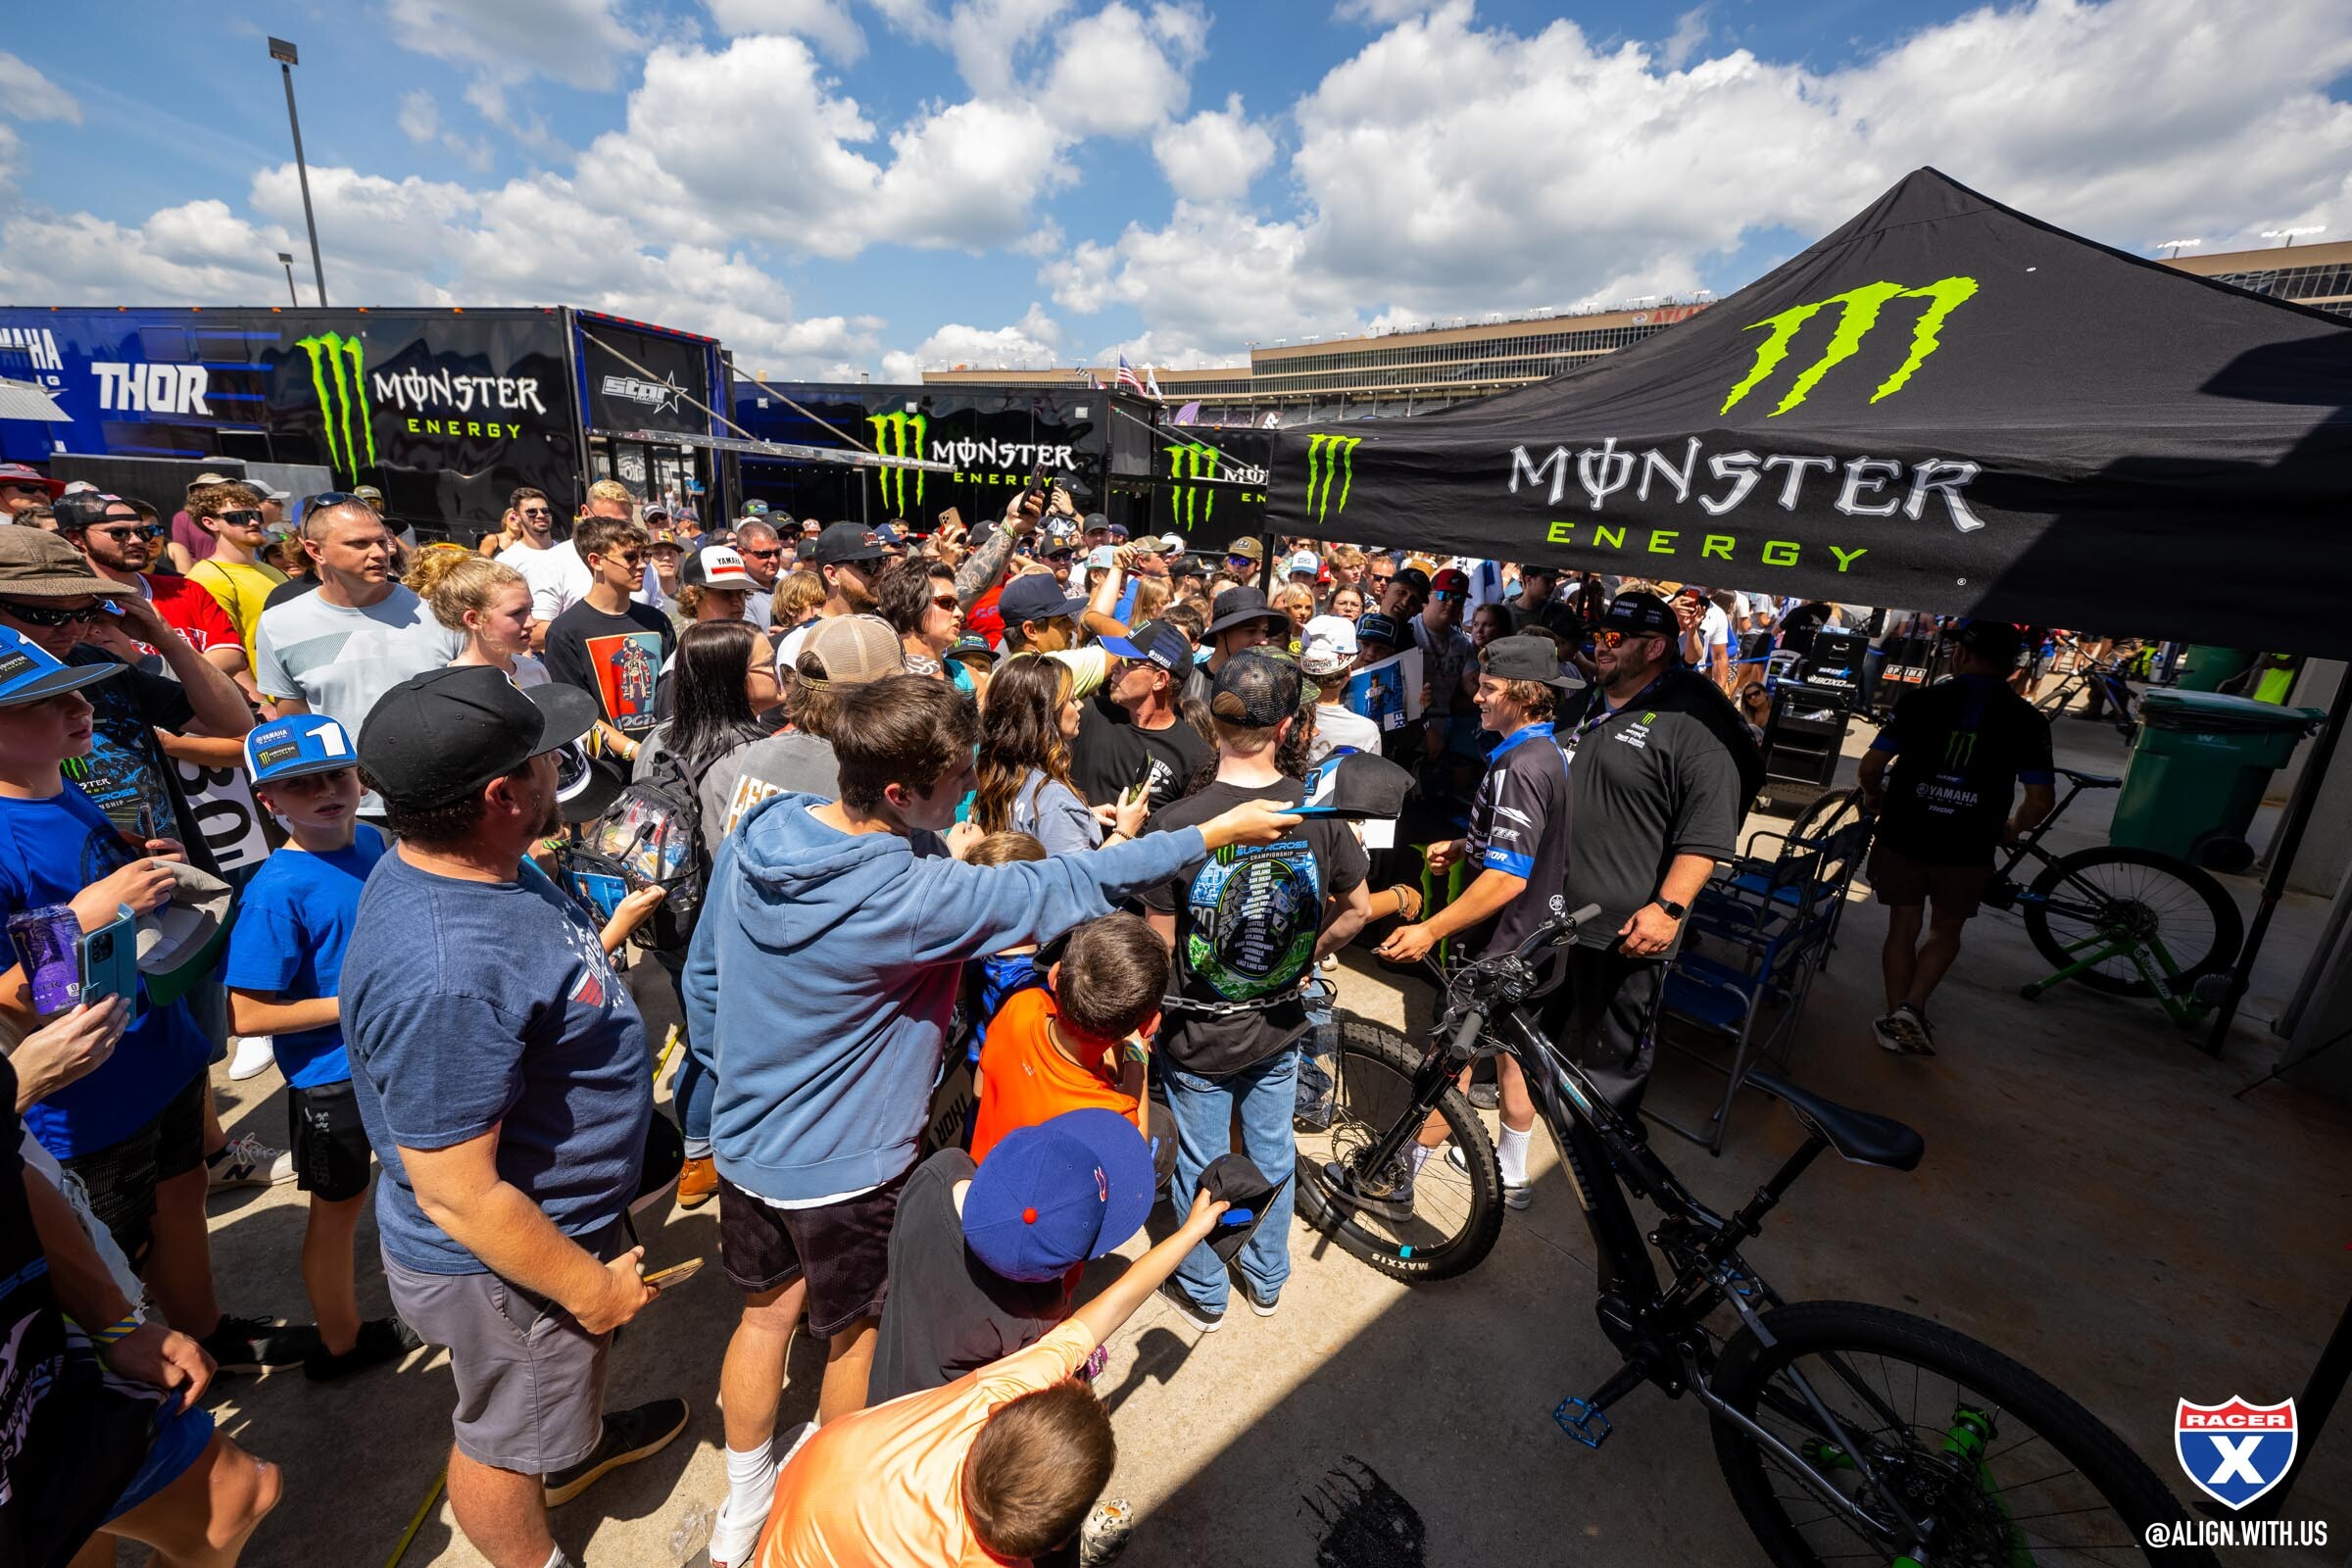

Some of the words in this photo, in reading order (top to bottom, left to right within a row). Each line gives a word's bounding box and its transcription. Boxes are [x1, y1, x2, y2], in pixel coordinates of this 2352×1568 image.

[91, 362, 209, 416] THOR
[373, 367, 547, 416] MONSTER
[408, 417, 520, 439] ENERGY
[932, 436, 1076, 471] MONSTER
[1509, 437, 1985, 533] MONSTER
[1546, 521, 1867, 572] ENERGY
[1153, 653, 1172, 668] YAMAHA
[1886, 666, 1923, 678] OPIMA
[262, 729, 288, 741] YAMAHA
[306, 722, 347, 757] 1
[1929, 785, 1979, 805] YAMAHA
[1250, 851, 1294, 861] CHAMPIONSHIP
[1372, 1252, 1430, 1271] MAXXIS
